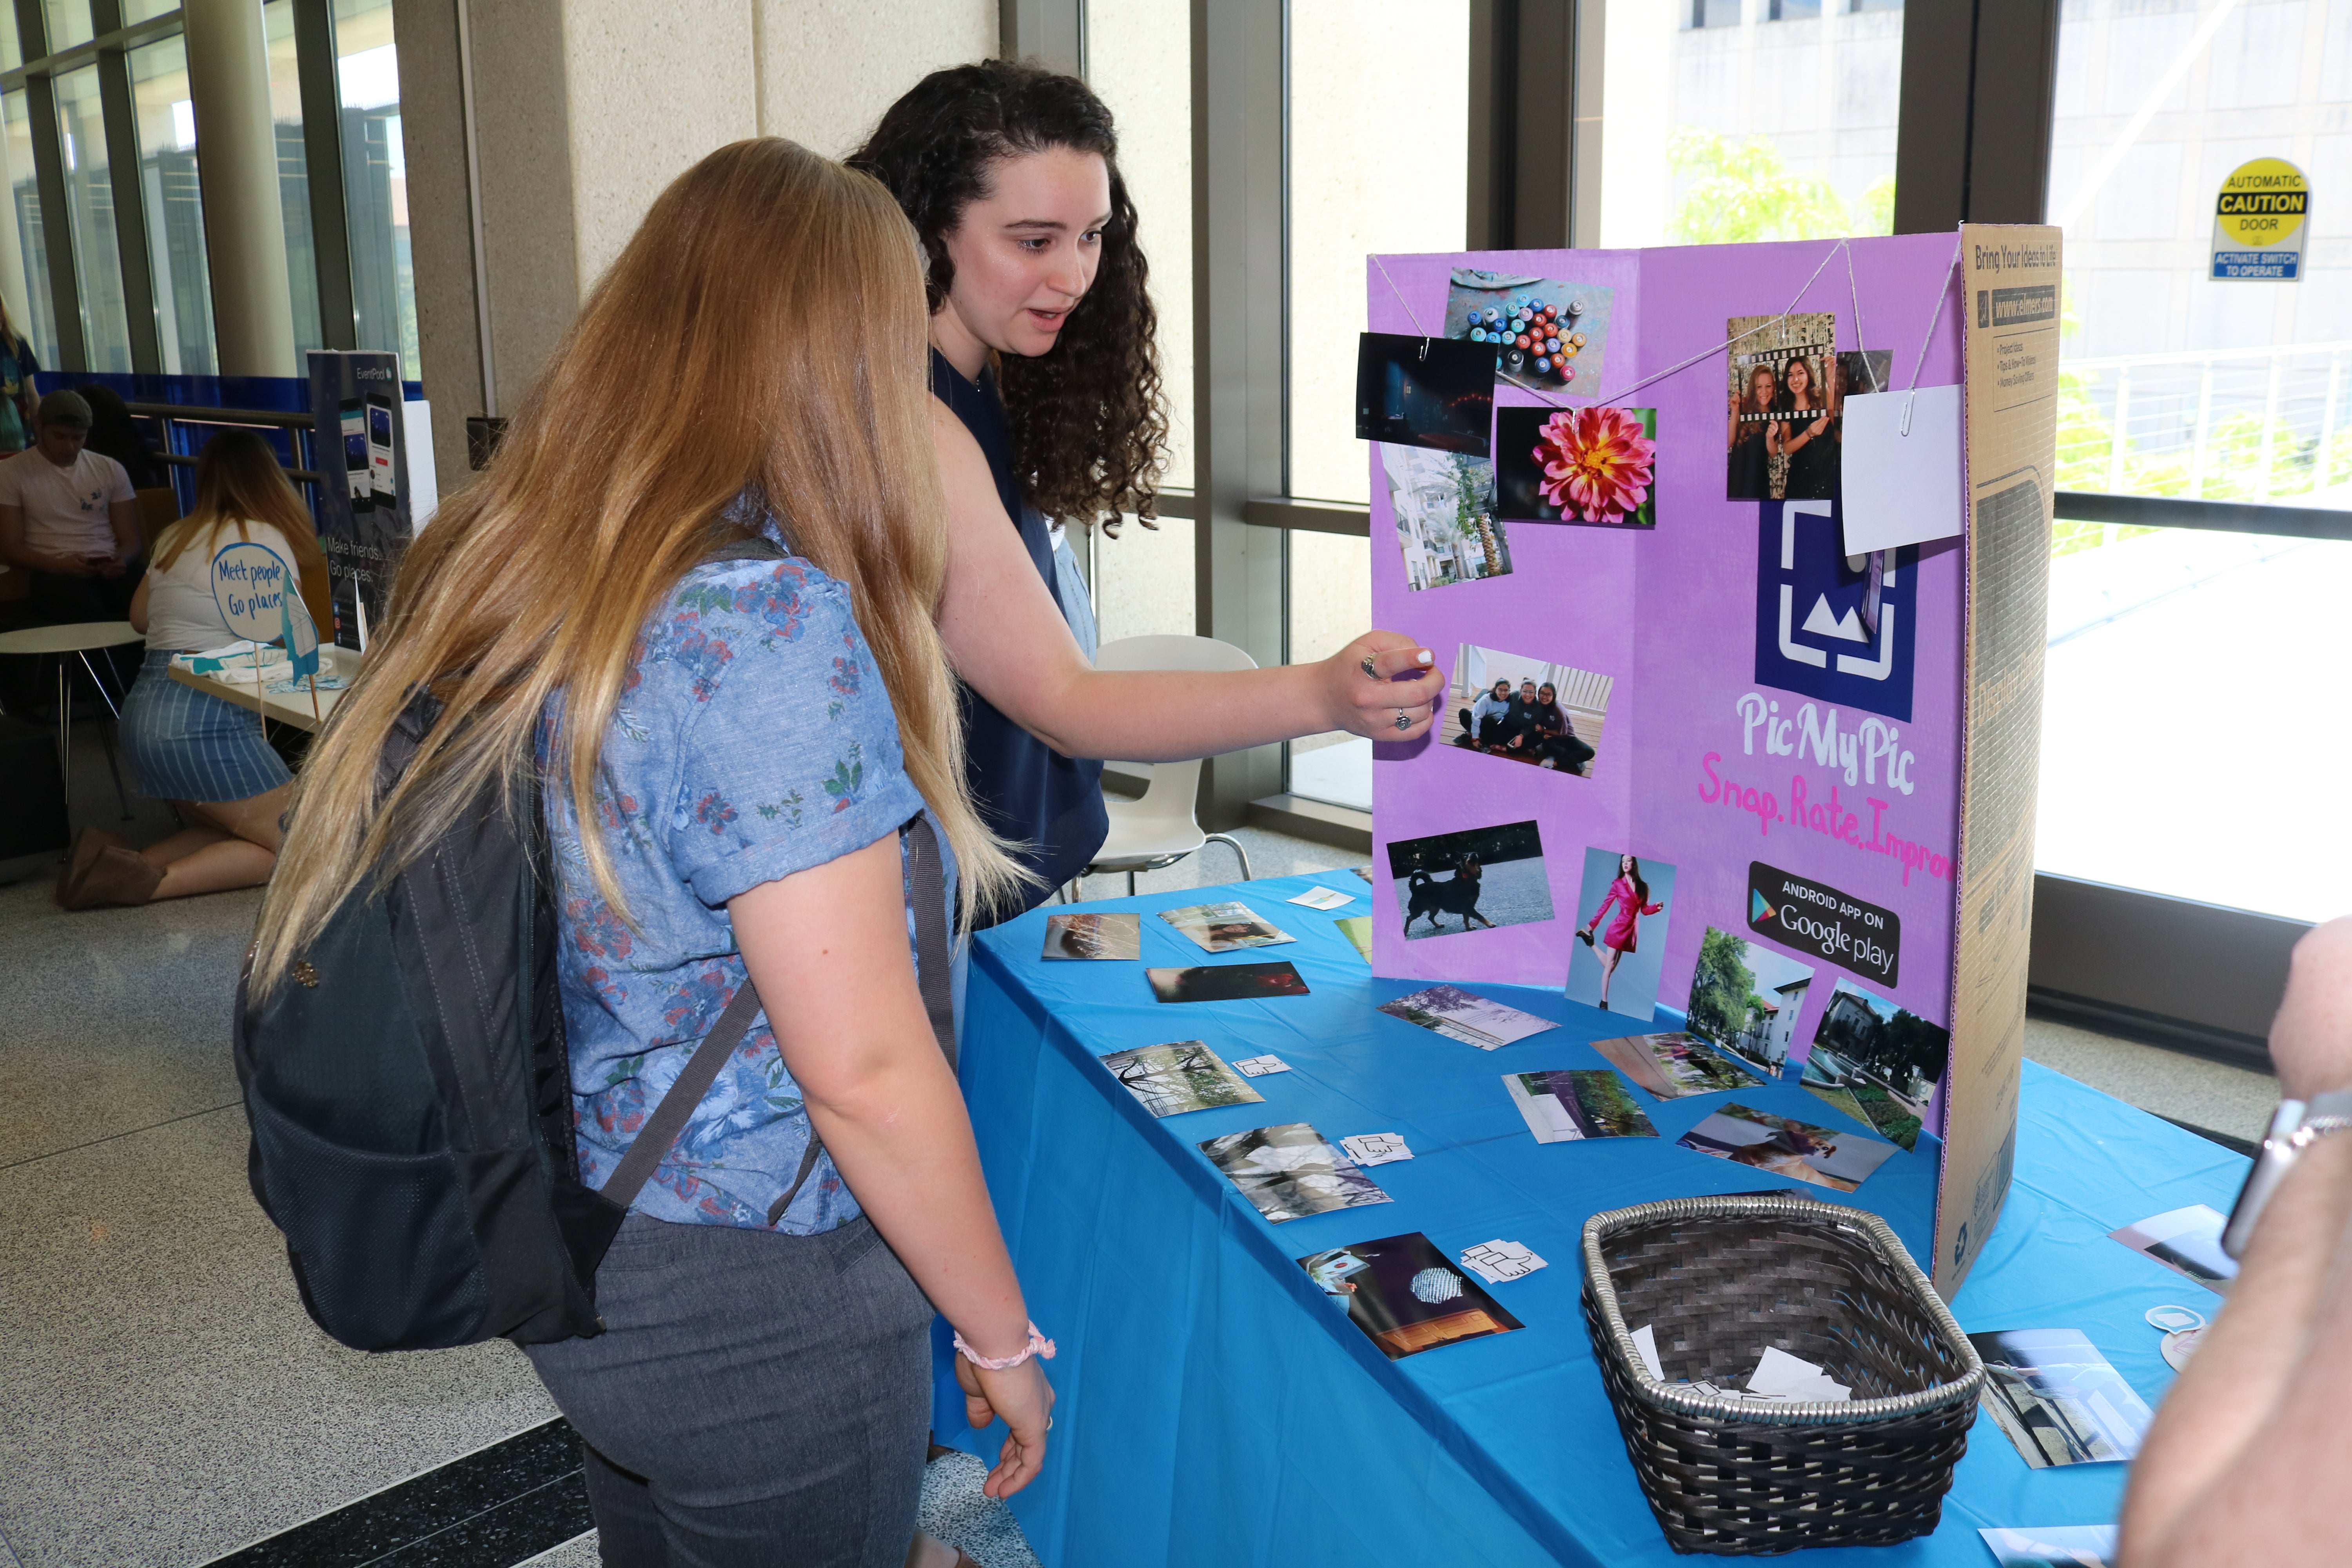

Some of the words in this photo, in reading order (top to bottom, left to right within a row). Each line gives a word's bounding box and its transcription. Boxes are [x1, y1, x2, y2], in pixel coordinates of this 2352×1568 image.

[2227, 175, 2301, 188] AUTOMATIC
[2220, 194, 2304, 212] CAUTION
[2239, 218, 2278, 230] DOOR
[1975, 245, 2000, 274] Bring
[2001, 244, 2020, 269] Your
[2022, 244, 2039, 268] Ideas
[2040, 245, 2045, 267] to
[2046, 244, 2056, 267] Life
[2215, 253, 2259, 264] ACTIVATE
[2260, 253, 2298, 264] SWITCH
[2226, 265, 2240, 276] TO
[2240, 265, 2284, 277] OPERATE
[1996, 292, 2053, 318] www.elmers.com
[2000, 343, 2013, 356] Project
[2013, 341, 2023, 352] Ideas
[357, 367, 385, 380] EventPool
[2000, 377, 2013, 388] Money
[328, 537, 348, 555] Make
[350, 540, 381, 561] friends.
[219, 559, 247, 581] Meet
[330, 560, 342, 577] Go
[229, 593, 244, 616] Go
[249, 592, 282, 620] places
[1698, 751, 1784, 836] Snap.
[1790, 775, 1865, 850] Rate.
[1782, 881, 1837, 910] ANDROID
[1839, 902, 1862, 920] APP
[1864, 912, 1884, 930] ON
[1780, 904, 1851, 955] Google
[1853, 937, 1894, 975] play
